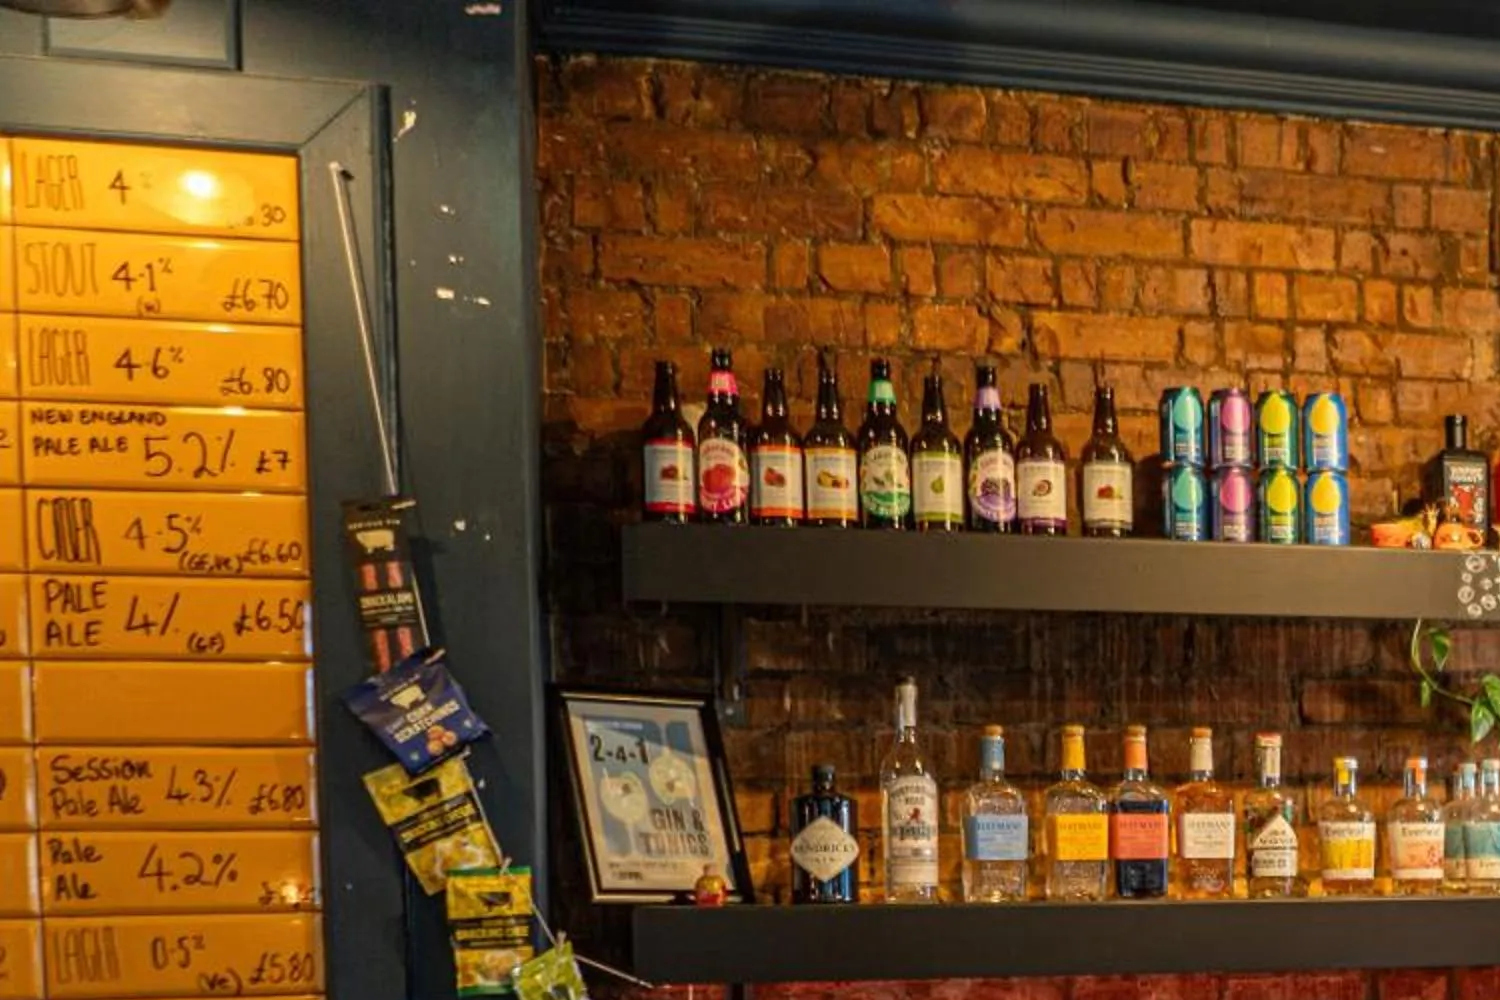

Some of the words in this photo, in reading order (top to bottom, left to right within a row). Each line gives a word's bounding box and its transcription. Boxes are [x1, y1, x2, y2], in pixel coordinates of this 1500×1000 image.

[21, 150, 86, 212] LAGER
[24, 241, 99, 297] STOUT
[27, 326, 91, 387] LAGER
[31, 409, 74, 426] NEW
[79, 409, 167, 426] ENGLAND
[33, 437, 81, 457] PALE
[89, 437, 129, 453] ALE
[143, 429, 236, 479] 5.2%
[255, 451, 291, 474] £7
[37, 497, 102, 565] CIDER
[42, 579, 108, 614] PALE
[46, 620, 104, 648] ALE
[124, 592, 181, 637] 4%
[590, 735, 649, 764] 2-4-1
[49, 787, 100, 818] Pale
[107, 785, 145, 816] Ale
[164, 766, 238, 808] 4.3%
[639, 831, 710, 857] TONICS
[652, 808, 686, 831] GIN
[46, 838, 103, 865] Pale
[55, 872, 97, 902] Ale
[137, 843, 239, 894] 4.2%
